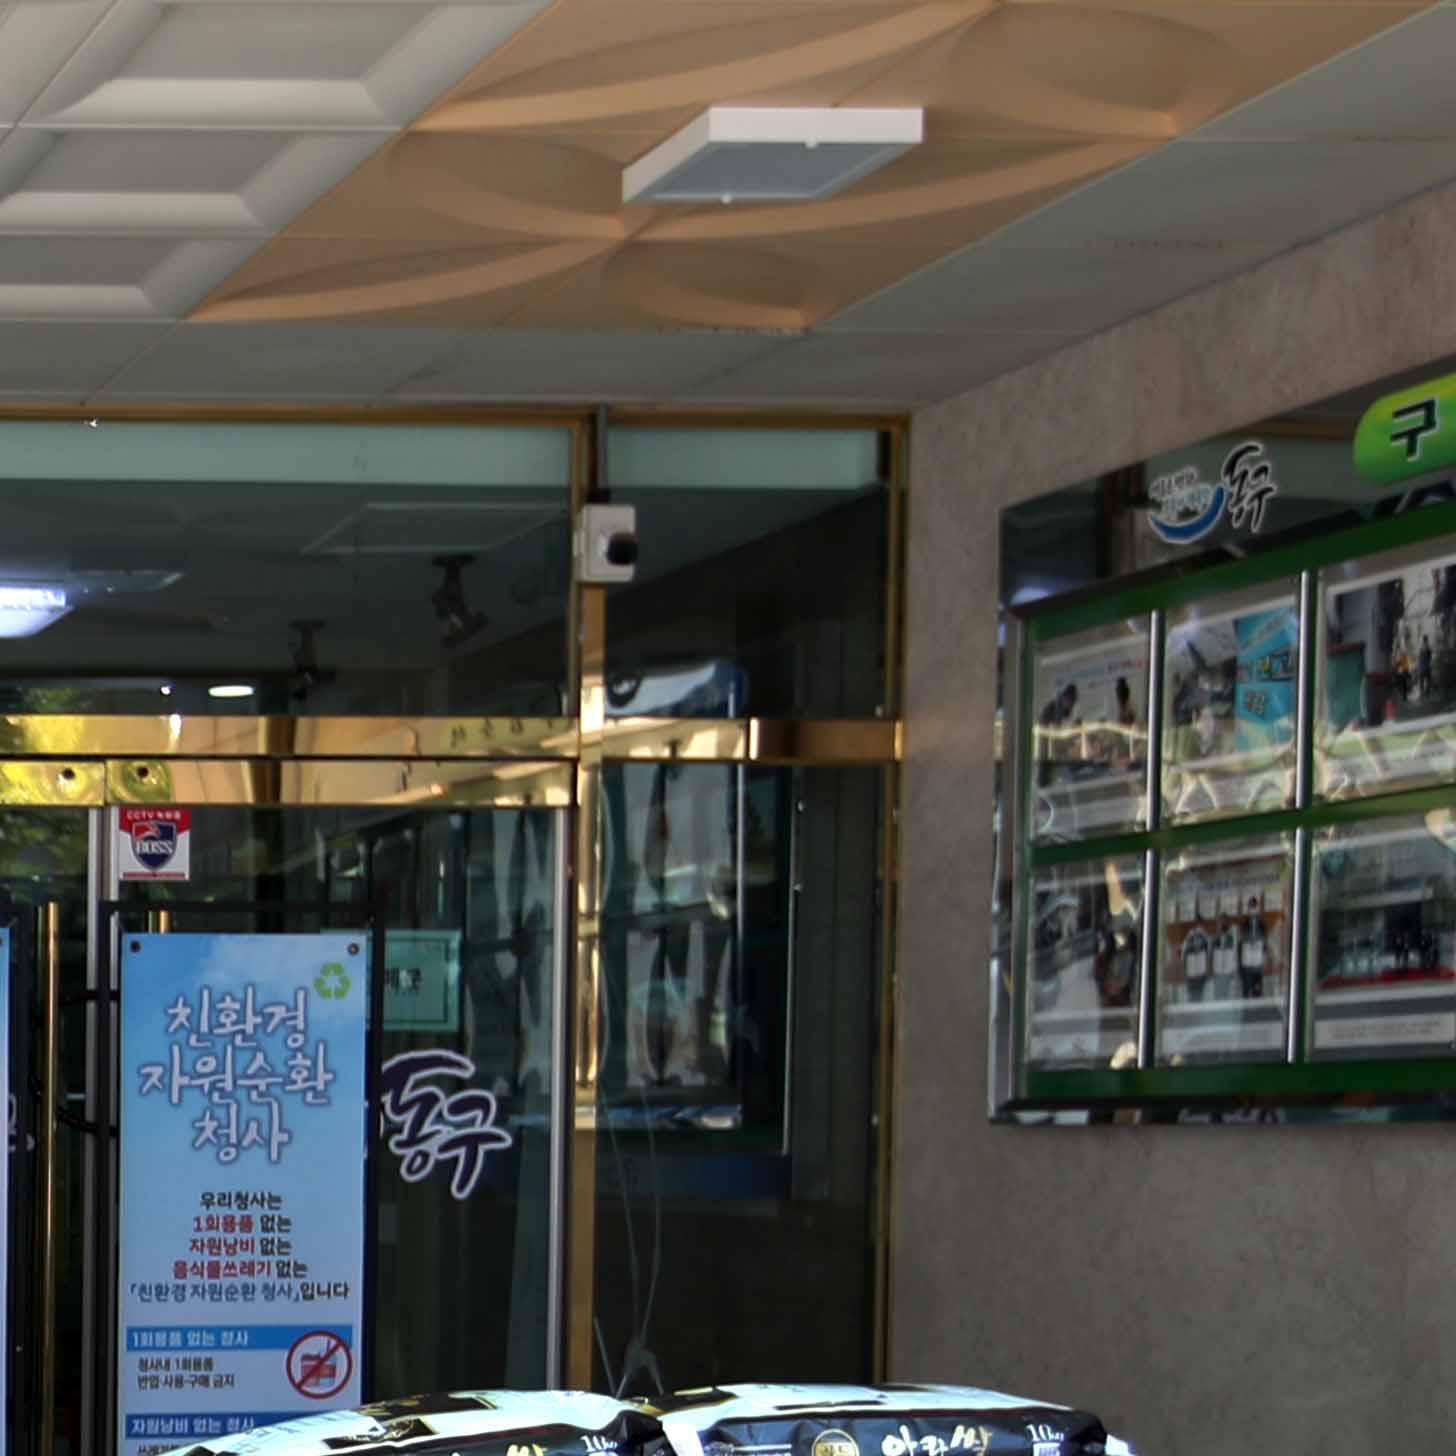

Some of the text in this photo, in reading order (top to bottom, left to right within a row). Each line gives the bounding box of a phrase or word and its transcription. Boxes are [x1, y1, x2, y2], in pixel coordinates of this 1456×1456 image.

[167, 984, 308, 1049] 친환경
[140, 1041, 335, 1105] 자원순환
[194, 1100, 290, 1163] 청사
[381, 1049, 512, 1199] 동구
[200, 1191, 283, 1211] 우리청사는
[193, 1215, 292, 1234] 1회용품 없는
[189, 1238, 292, 1257] 자원낭비 없는
[173, 1260, 308, 1279] 음식물쓰레기 없는
[190, 1283, 257, 1302] 자원순환
